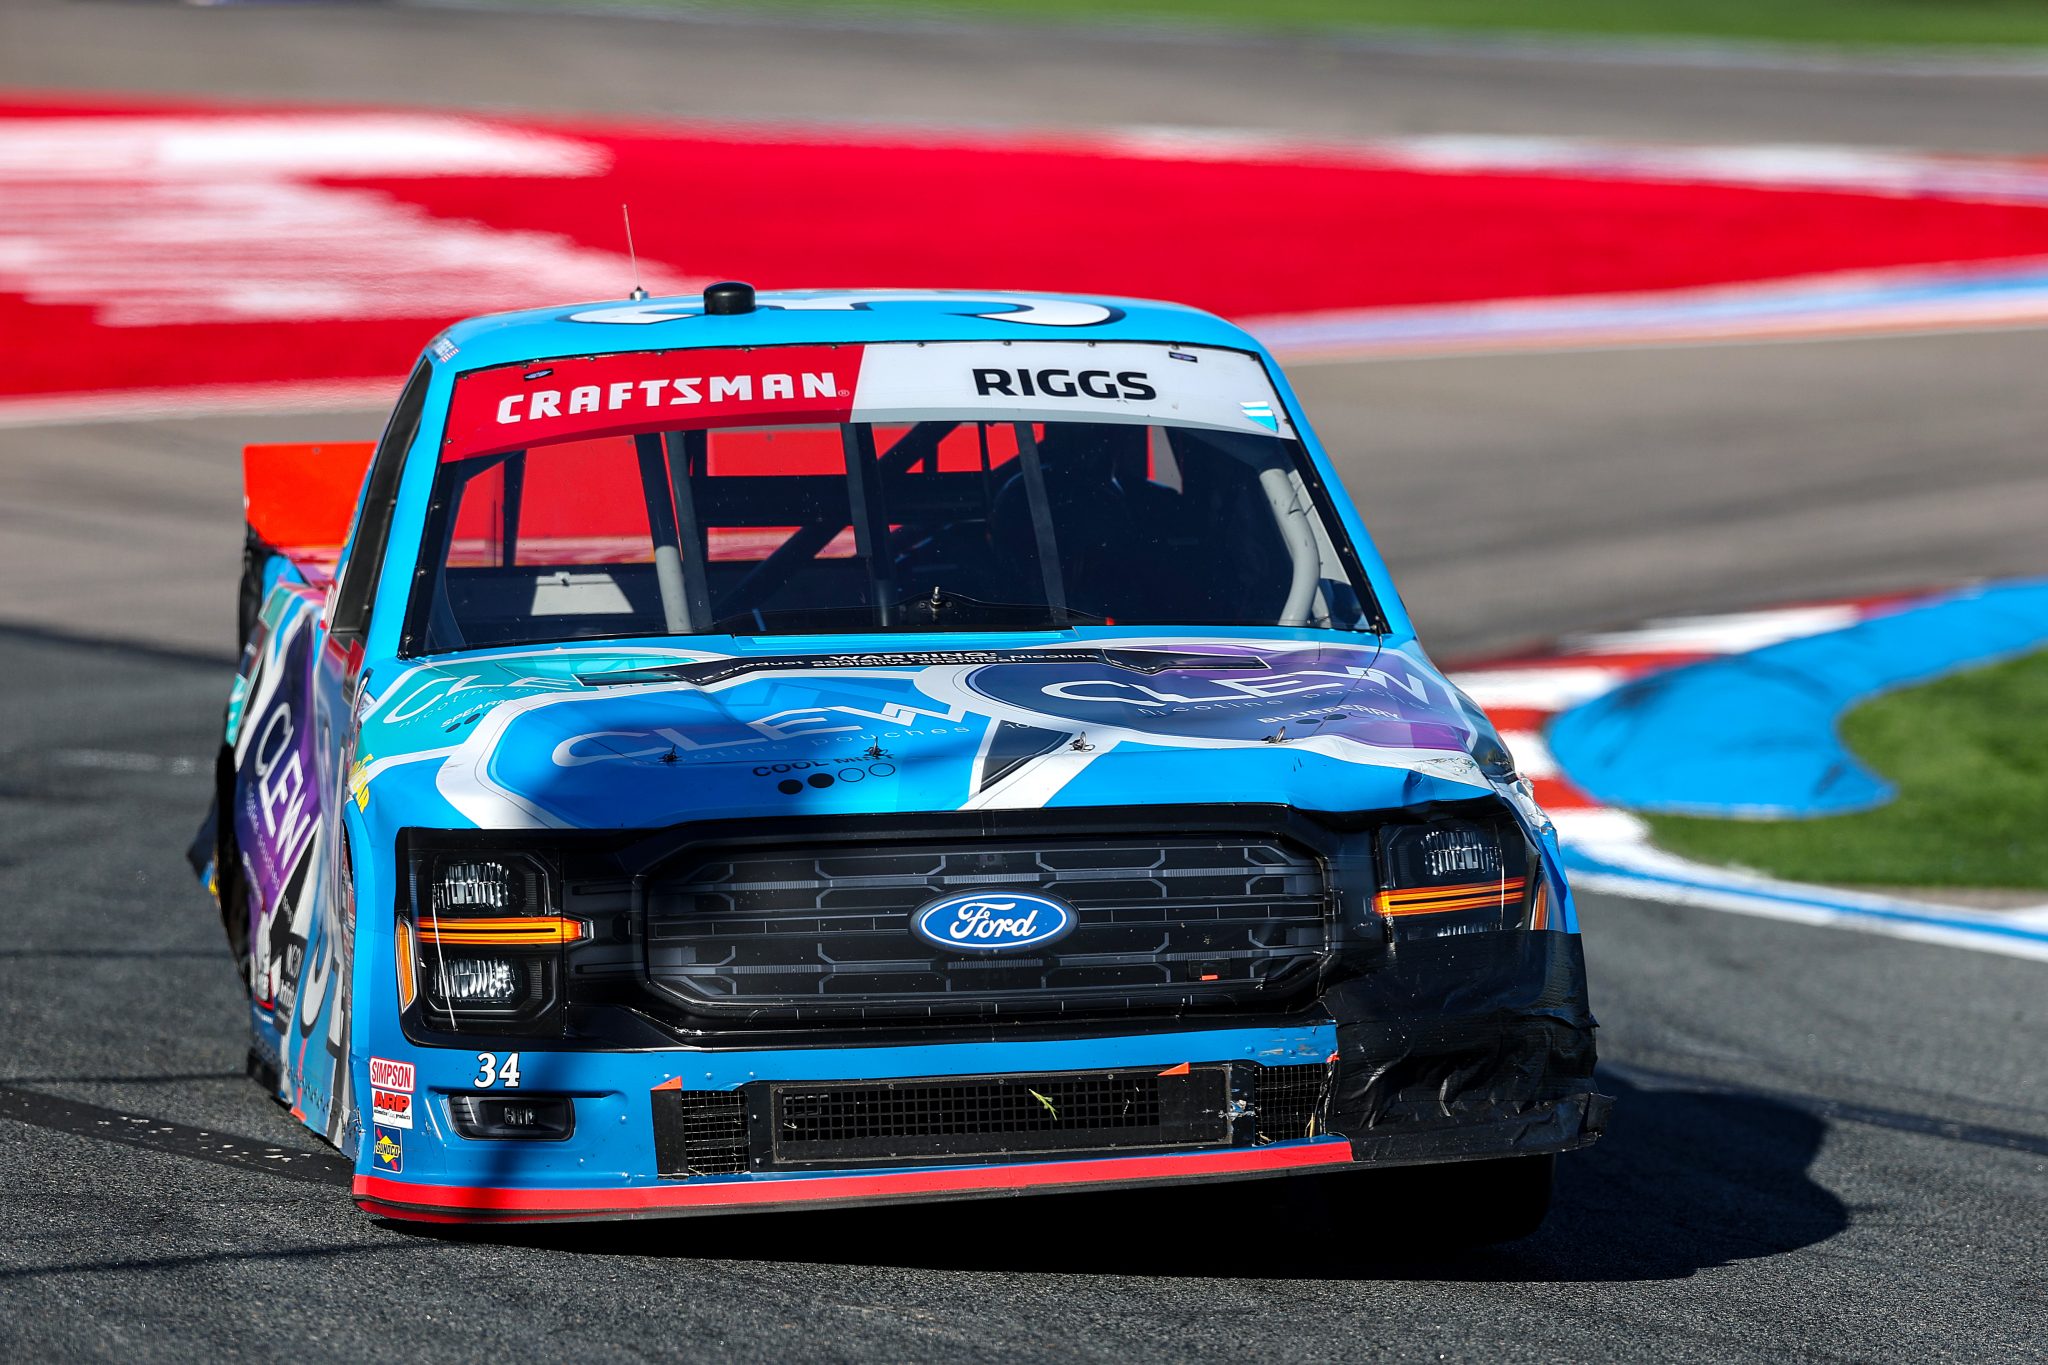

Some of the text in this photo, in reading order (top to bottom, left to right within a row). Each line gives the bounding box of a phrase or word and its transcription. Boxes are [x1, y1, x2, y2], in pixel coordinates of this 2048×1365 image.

[497, 372, 837, 424] CRAFTSMAN
[972, 368, 1157, 401] RIGGS
[383, 675, 632, 724] CLE
[1041, 666, 1430, 707] CLEW
[552, 702, 963, 767] CLEW
[811, 725, 971, 747] pouches
[255, 702, 310, 871] CLEW
[752, 760, 829, 777] COOL
[950, 902, 1039, 939] Ford
[371, 1061, 412, 1089] SIMPSON
[474, 1052, 520, 1088] 34
[374, 1091, 410, 1113] ARP
[376, 1142, 400, 1157] SUNOCO
